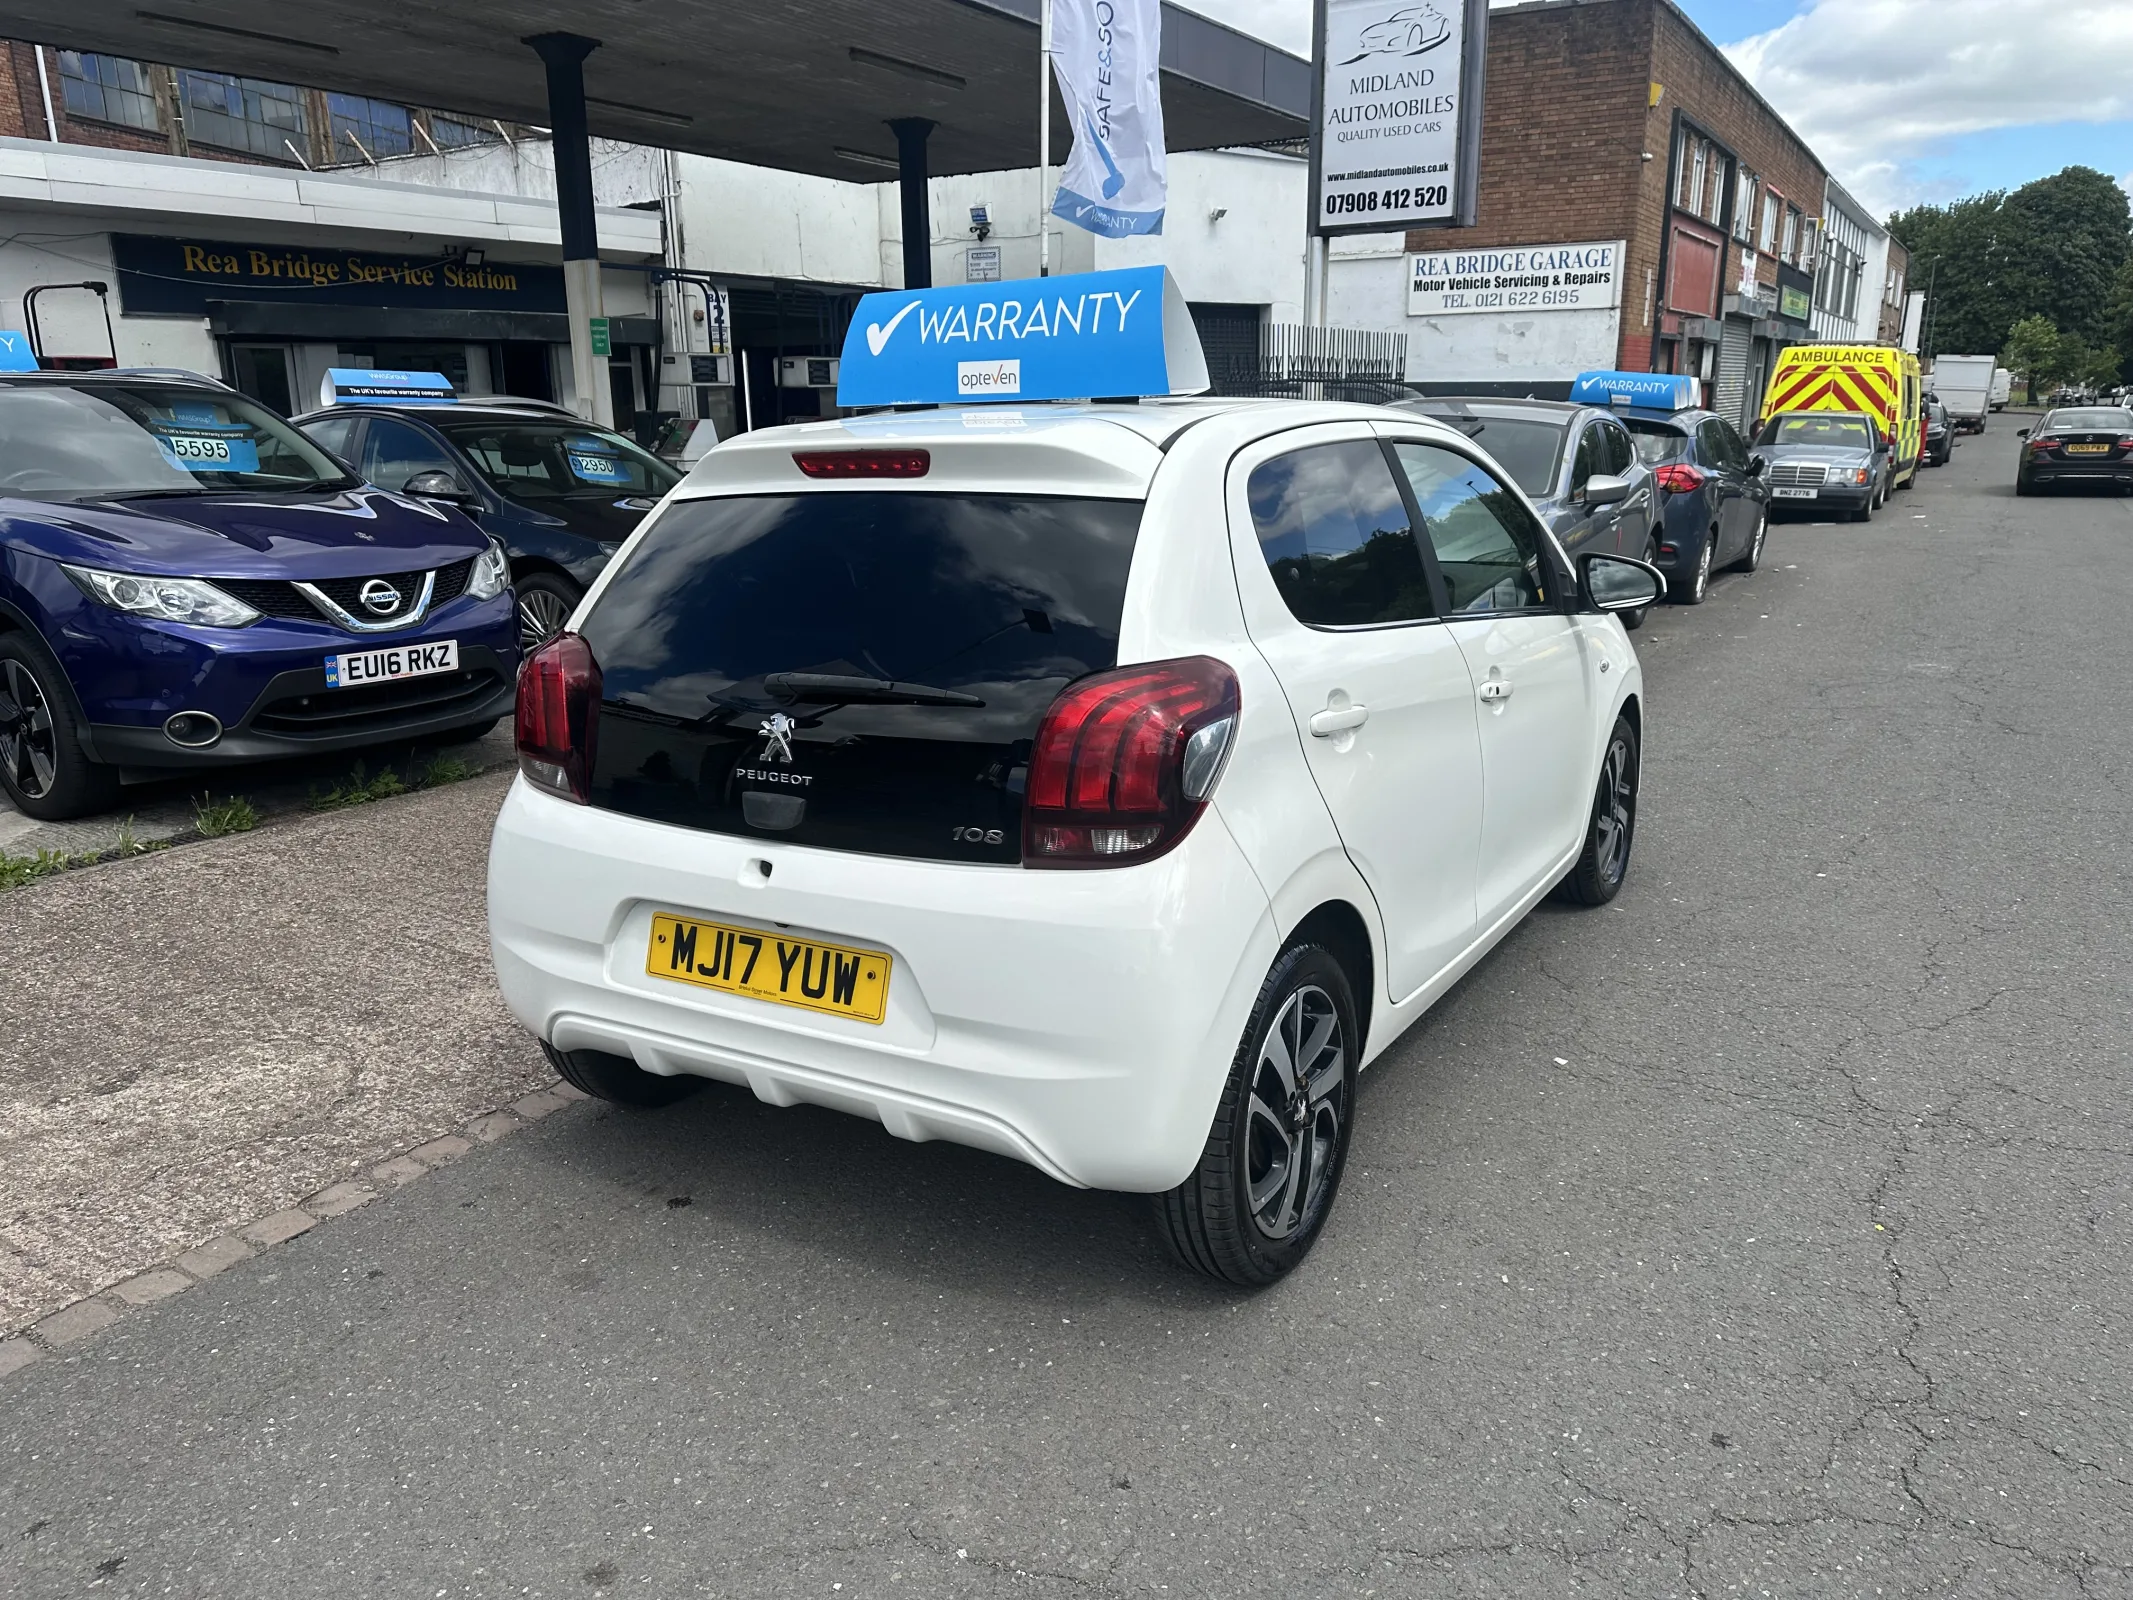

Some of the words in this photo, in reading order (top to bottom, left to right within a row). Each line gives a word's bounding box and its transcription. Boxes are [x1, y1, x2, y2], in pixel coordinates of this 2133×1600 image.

[1350, 69, 1435, 95] MIDLAND
[1328, 95, 1454, 125] AUTOMOBILES
[1337, 128, 1382, 143] QUALITY
[1383, 125, 1412, 137] USED
[1414, 121, 1442, 134] CARS
[1327, 162, 1449, 182] www.midlandautomobiles.co.uk
[1326, 191, 1378, 215] 07908
[1381, 188, 1410, 210] 412
[1414, 185, 1448, 207] 520
[183, 245, 240, 275] Rea
[248, 250, 340, 287] Bridge
[347, 256, 435, 286] Service
[444, 264, 518, 291] Station
[1415, 257, 1451, 276] REA
[1455, 252, 1526, 274] BRIDGE
[1530, 248, 1612, 271] GARAGE
[1413, 279, 1446, 292] Motor
[1449, 277, 1491, 291] Vehicle
[1494, 274, 1549, 289] Servicing
[1552, 274, 1561, 286] &
[1564, 271, 1611, 286] Repairs
[1442, 294, 1472, 308] TEL.
[1475, 292, 1503, 307] 0121
[1508, 291, 1538, 306] 622
[1542, 289, 1580, 304] 6195
[919, 289, 1142, 345] WARRANTY
[1790, 351, 1885, 363] AMBULANCE
[961, 364, 1017, 389] opteven
[1599, 378, 1670, 394] WARRANTY
[571, 457, 614, 473] £2950
[366, 591, 399, 601] NISSAN
[347, 651, 401, 681] EU16
[408, 645, 451, 672] RKZ
[326, 674, 338, 683] UK
[736, 768, 813, 786] PEUGEOT
[952, 826, 1005, 845] 108
[670, 923, 763, 985] MJ17
[776, 941, 861, 1006] YUW
